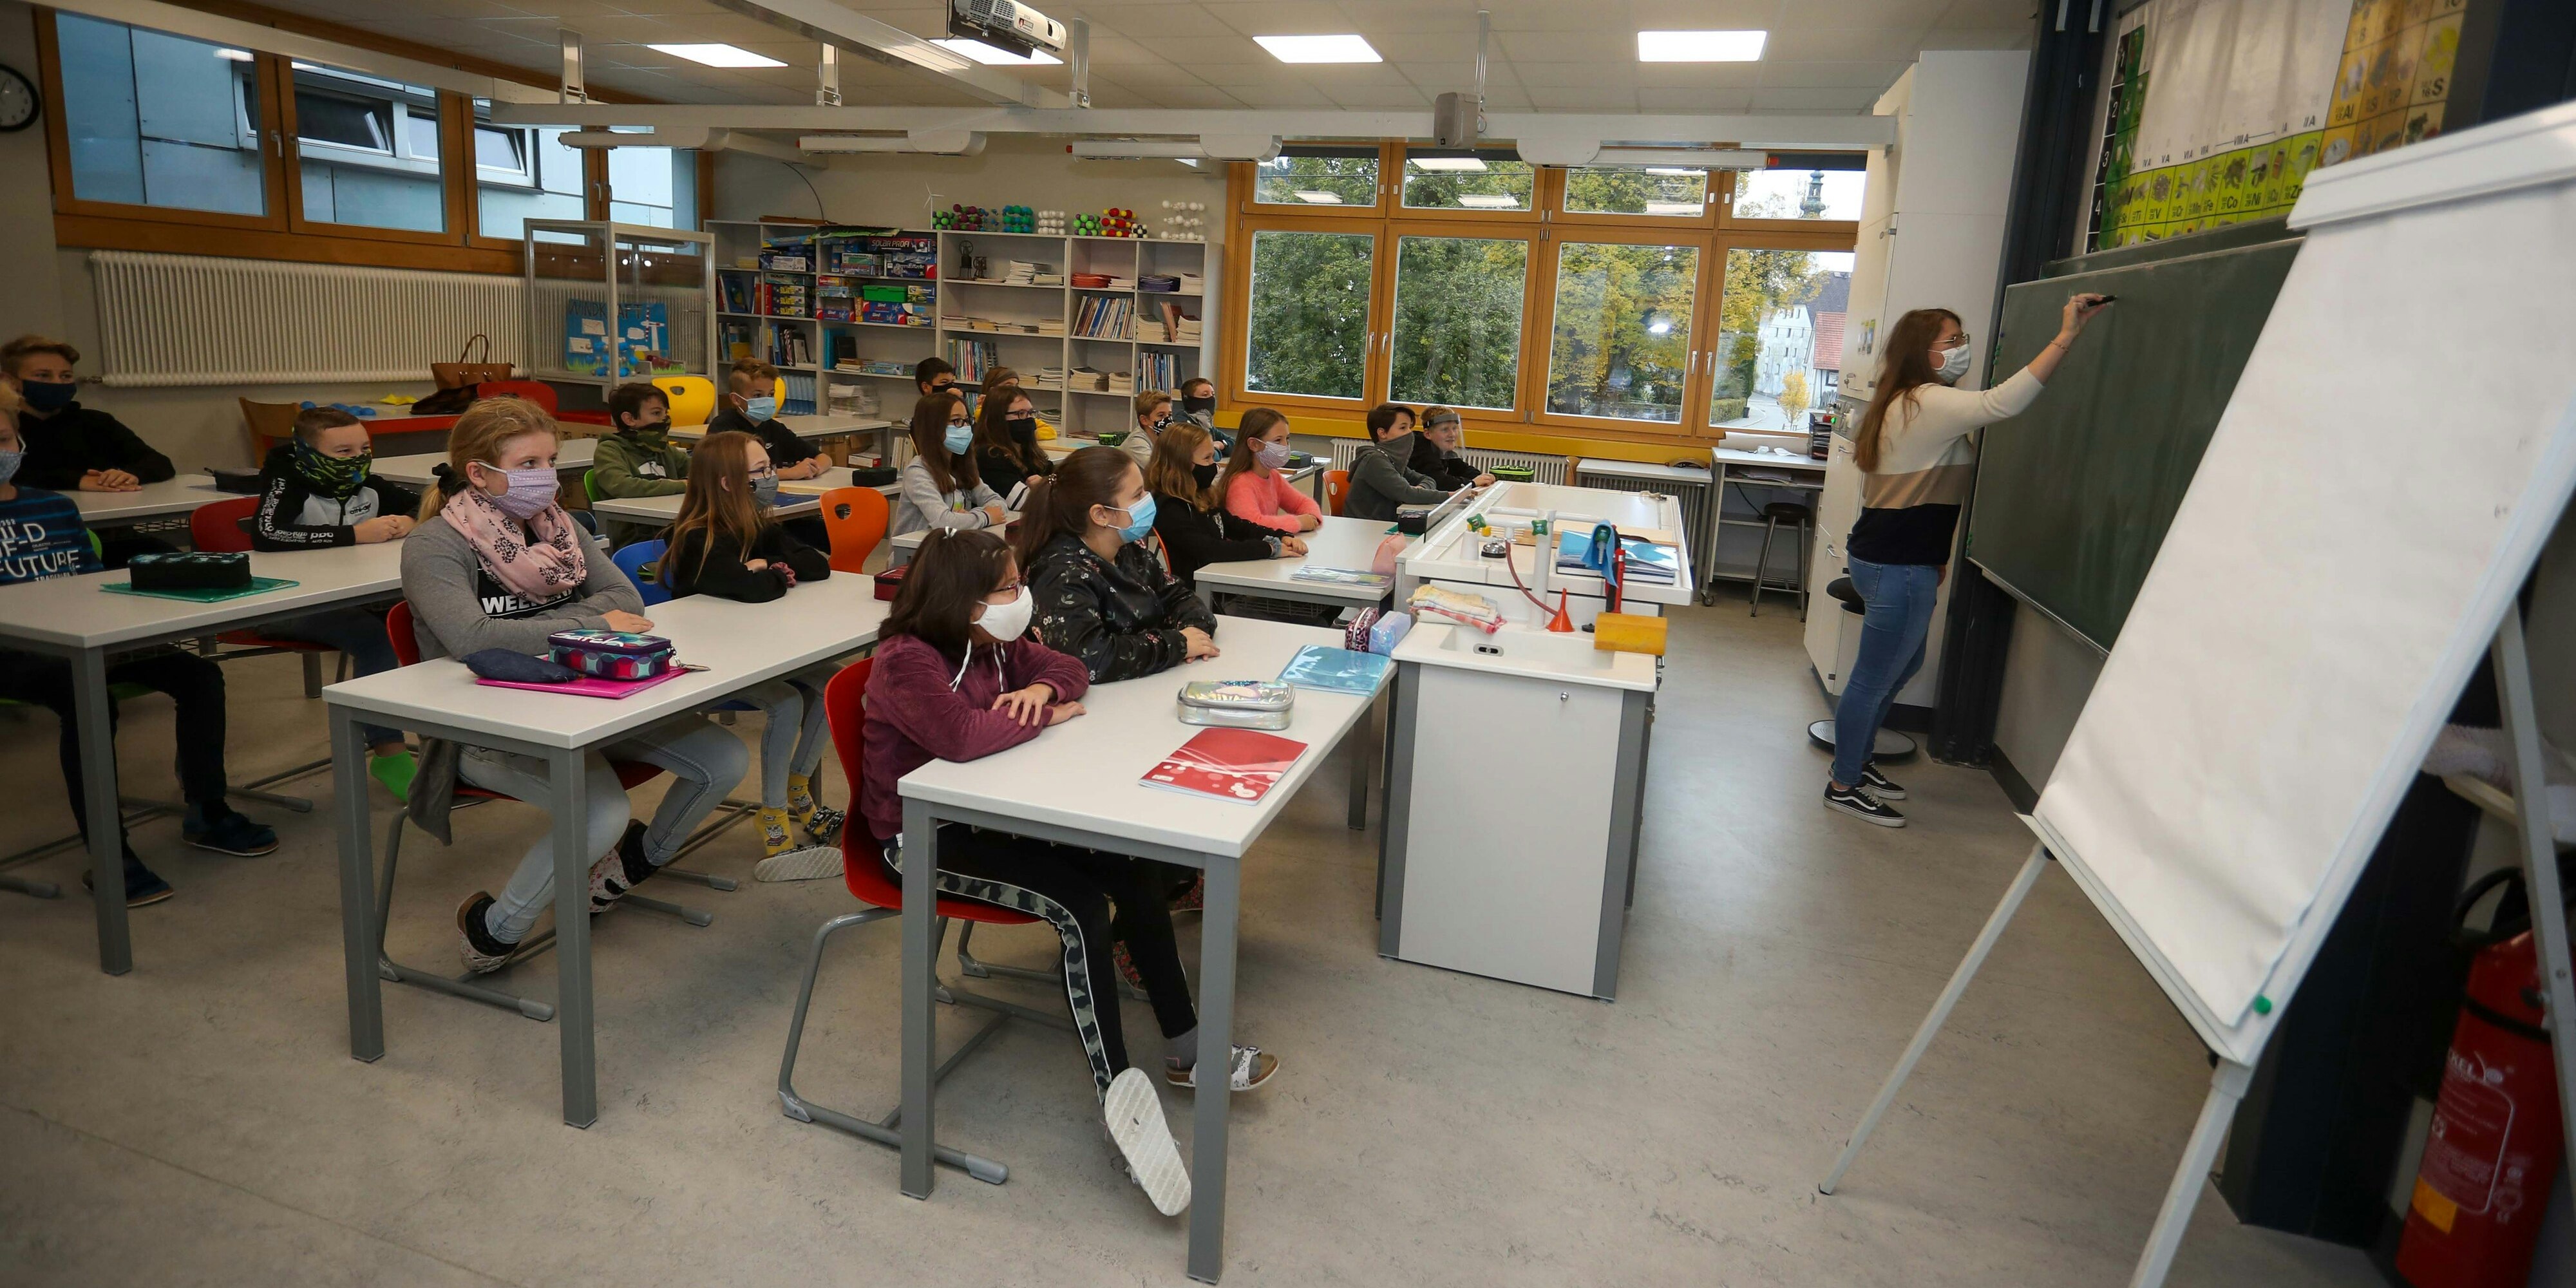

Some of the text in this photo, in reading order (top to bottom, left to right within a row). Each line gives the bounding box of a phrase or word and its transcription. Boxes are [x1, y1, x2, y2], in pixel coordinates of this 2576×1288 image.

[2432, 78, 2445, 95] S
[2111, 101, 2119, 118] 2
[2102, 152, 2110, 167] 3
[2095, 203, 2101, 215] 4
[2227, 196, 2238, 208] Co
